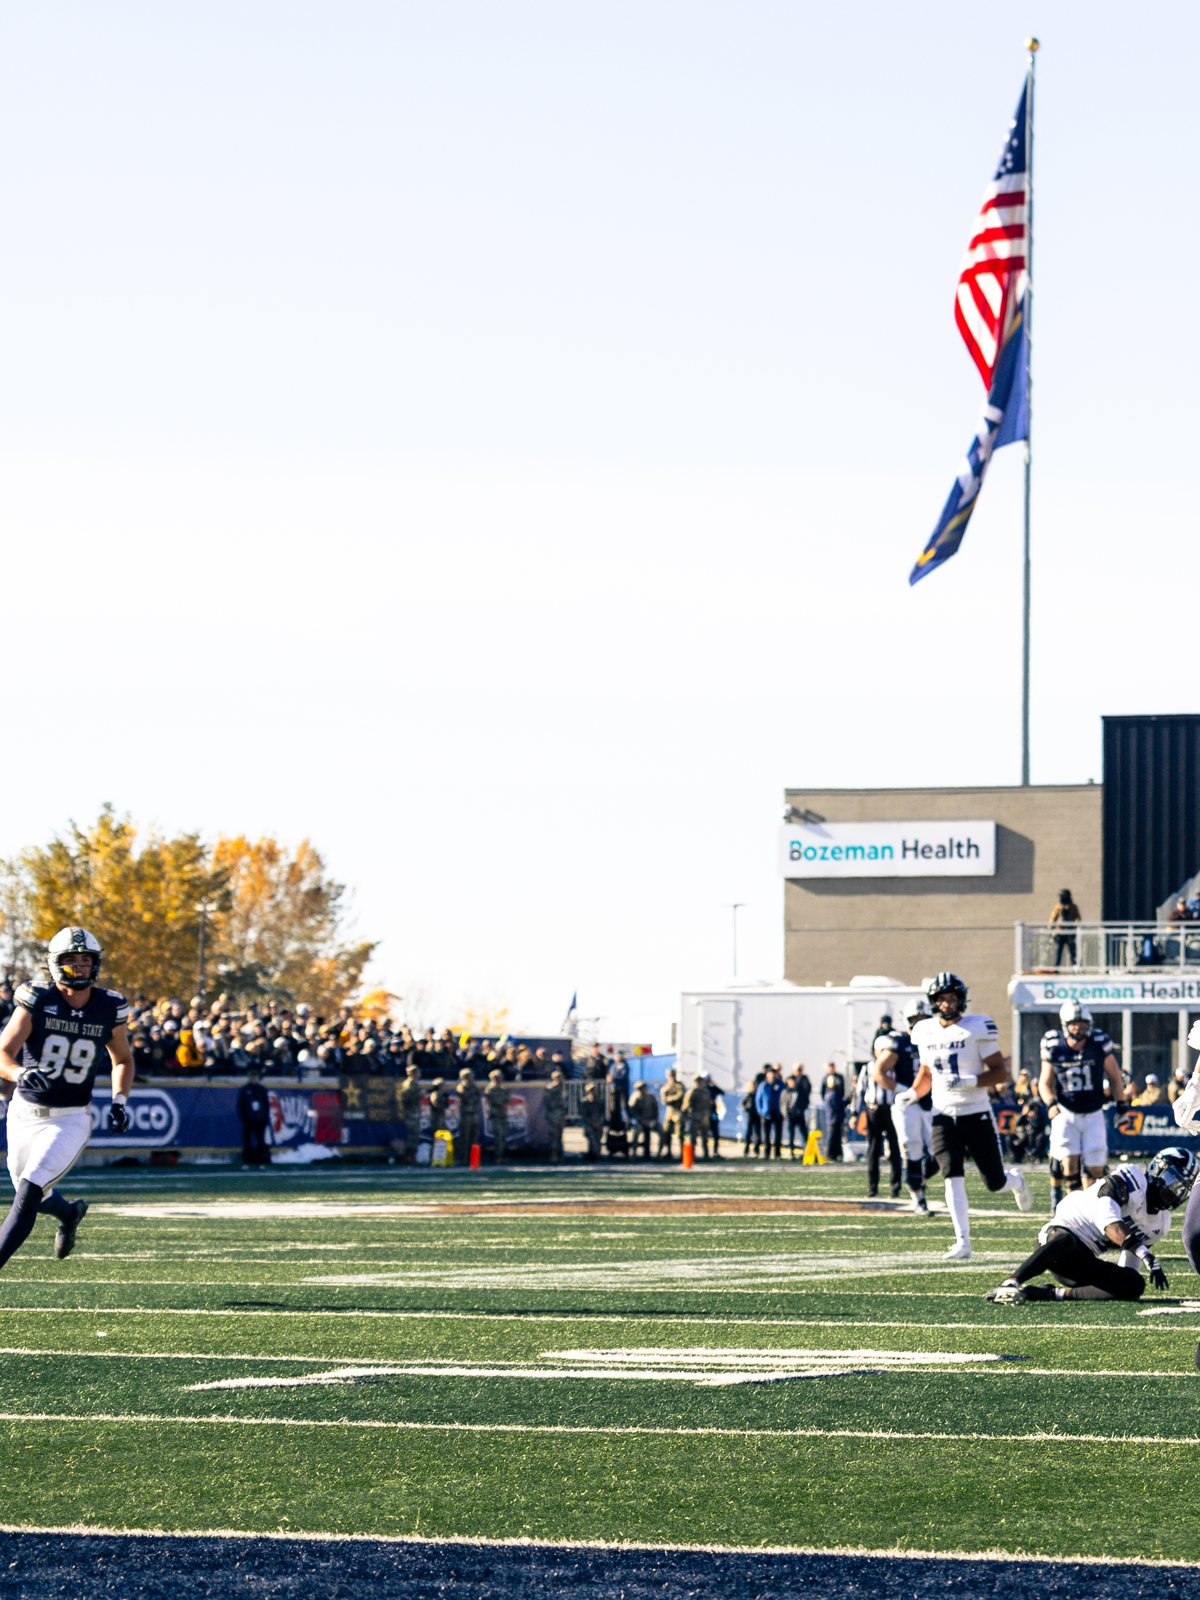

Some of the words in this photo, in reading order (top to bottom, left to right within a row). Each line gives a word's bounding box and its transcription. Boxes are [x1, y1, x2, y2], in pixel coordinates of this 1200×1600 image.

[789, 840, 894, 862] Bozeman
[901, 837, 980, 860] Health
[1043, 981, 1135, 1000] Bozeman
[45, 1016, 79, 1035] MONTANA
[82, 1023, 104, 1038] STATE
[38, 1033, 96, 1085] 89
[1065, 1064, 1094, 1092] 61
